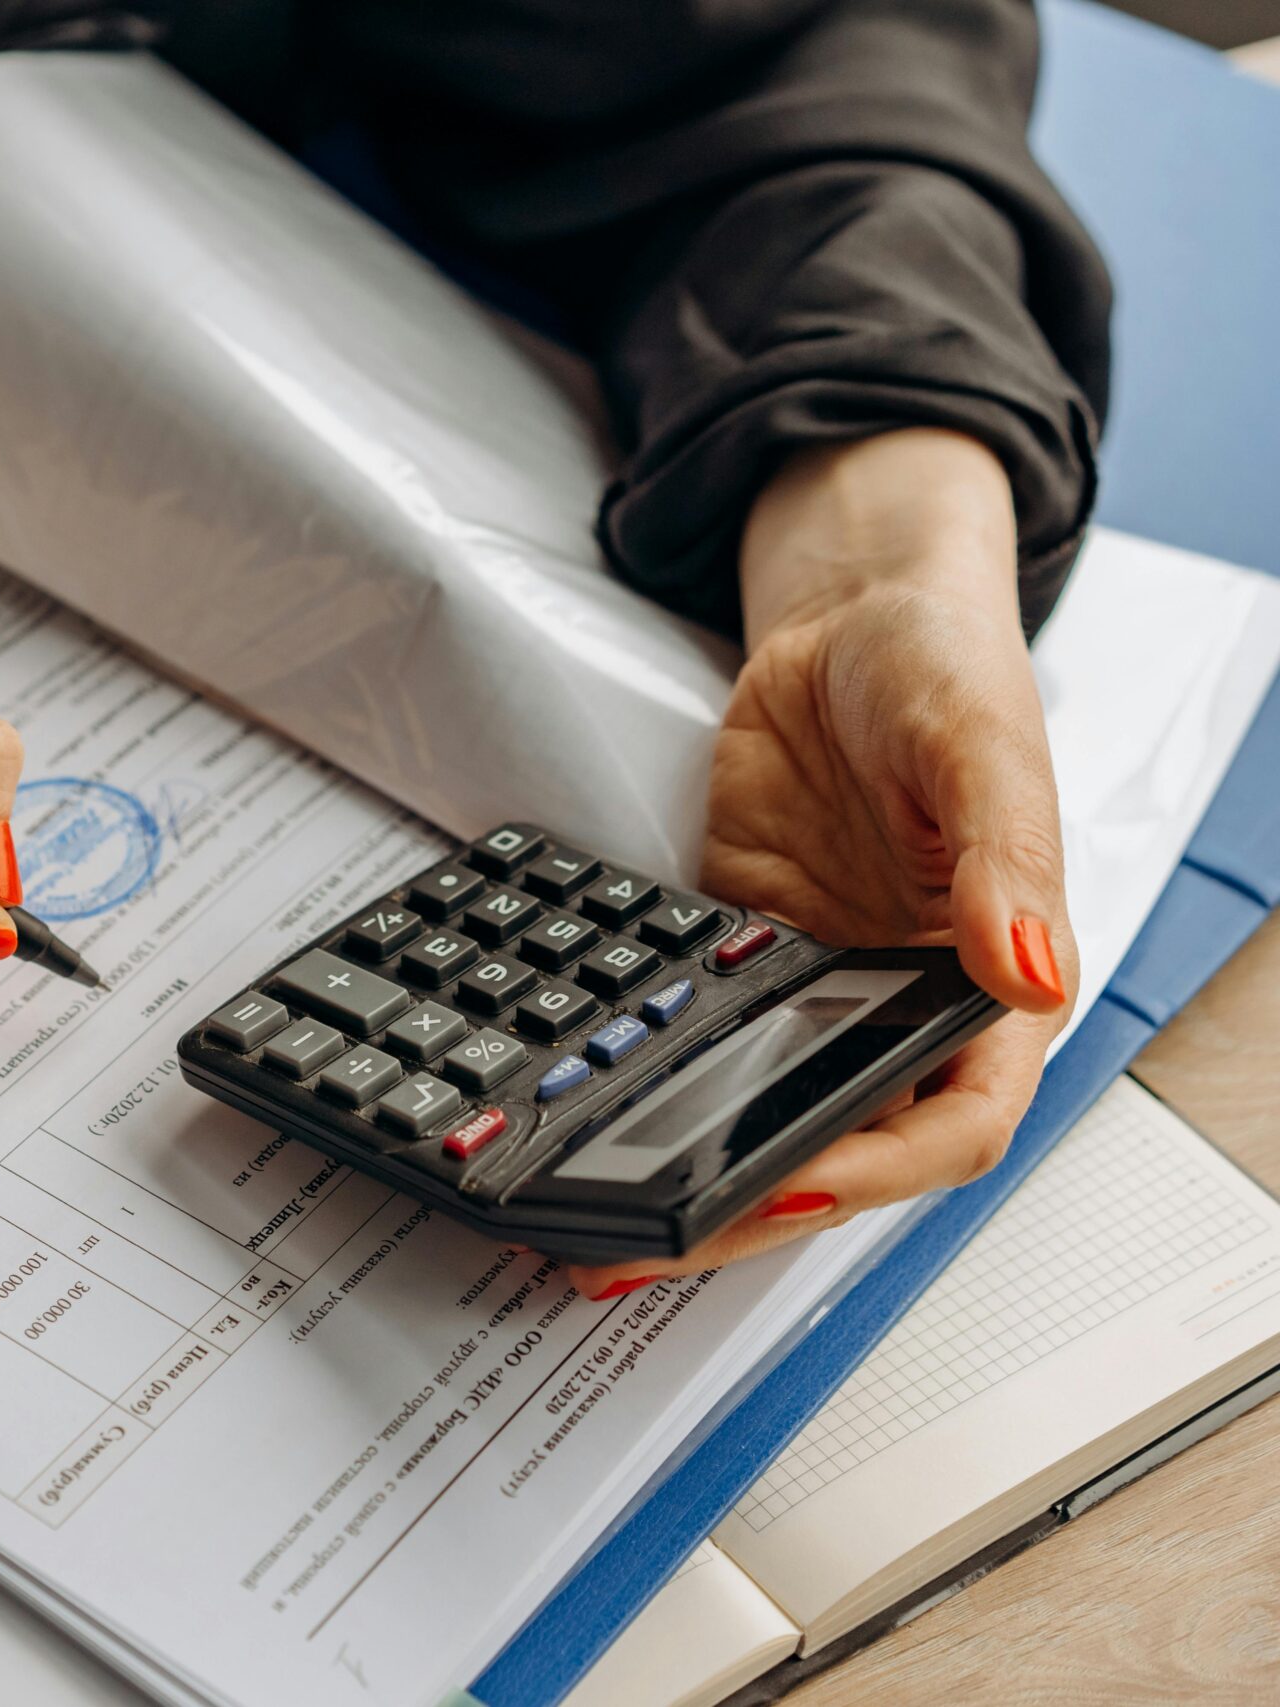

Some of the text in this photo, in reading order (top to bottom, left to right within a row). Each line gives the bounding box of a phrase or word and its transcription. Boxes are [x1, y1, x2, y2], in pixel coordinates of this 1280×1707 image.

[489, 831, 522, 850] 0
[554, 860, 577, 870] 1
[608, 881, 631, 897] 4
[488, 895, 520, 914] 2
[672, 908, 701, 925] 7
[548, 921, 579, 938] 5
[729, 926, 768, 950] OFF
[425, 938, 457, 956] 3
[604, 947, 638, 969] 8
[85, 962, 132, 1001] 00000
[478, 964, 507, 981] 6
[140, 978, 188, 1017] Итого:
[539, 992, 569, 1009] 9
[650, 982, 687, 1007] MRC
[55, 999, 89, 1026] (сто
[466, 1040, 504, 1060] %
[553, 1056, 581, 1078] M+
[87, 1059, 182, 1136] 01.12.2020г.)
[232, 1170, 252, 1186] из
[120, 1206, 134, 1215] 1
[77, 1234, 100, 1254] шт
[18, 1251, 48, 1275] 100
[288, 1203, 432, 1344] аботы (оказаны услуги):
[241, 1274, 261, 1291] во
[455, 1248, 520, 1309] кументов:
[256, 1279, 293, 1310] Кол-
[488, 1259, 559, 1327] йвГлобал»
[23, 1280, 90, 1339] 30 000,00
[536, 1286, 579, 1328] азчика
[622, 1283, 670, 1329] 12/20/2
[210, 1314, 240, 1333] Ед.
[477, 1329, 488, 1339] с
[504, 1330, 542, 1366] ООО
[607, 1328, 625, 1345] от
[432, 1337, 479, 1387] другой
[129, 1344, 208, 1415] Цена (руб)
[463, 1367, 503, 1410] «ИДС
[499, 1265, 722, 1498] чи-приемки работ (оказания услуг)
[545, 1346, 613, 1414] 09.12.2020
[374, 1385, 435, 1441] стороны,
[396, 1408, 468, 1479] Боржоми»
